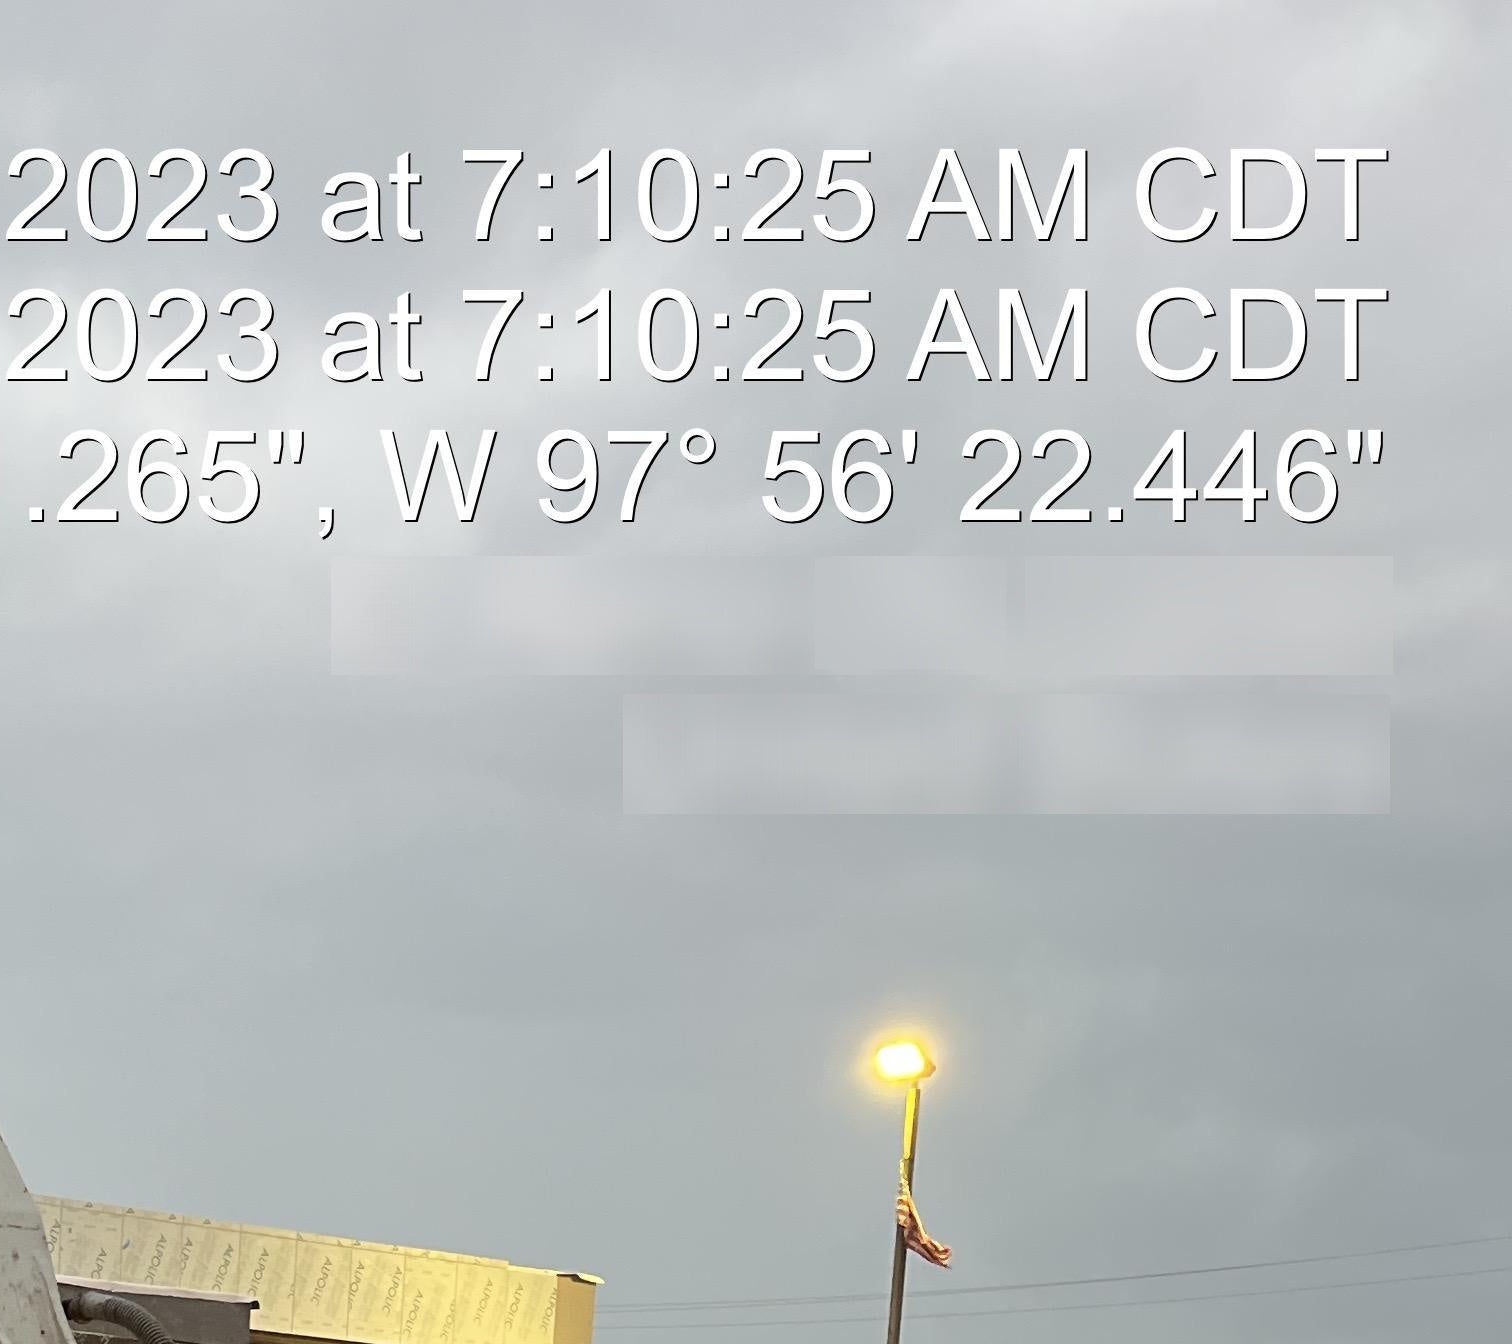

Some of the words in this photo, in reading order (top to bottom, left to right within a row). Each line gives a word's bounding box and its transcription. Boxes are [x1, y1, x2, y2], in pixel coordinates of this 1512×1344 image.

[144, 1232, 168, 1286] ALPOLIC
[212, 1243, 235, 1292] ALPOLIC
[248, 1248, 270, 1298] ALPOLIC
[311, 1256, 333, 1306] ALPOLIC
[382, 1265, 404, 1315] ALPOLIC
[404, 1288, 425, 1338] ALPOLIC
[474, 1277, 494, 1327] ALPOLIC
[505, 1281, 525, 1331] ALPOLIC
